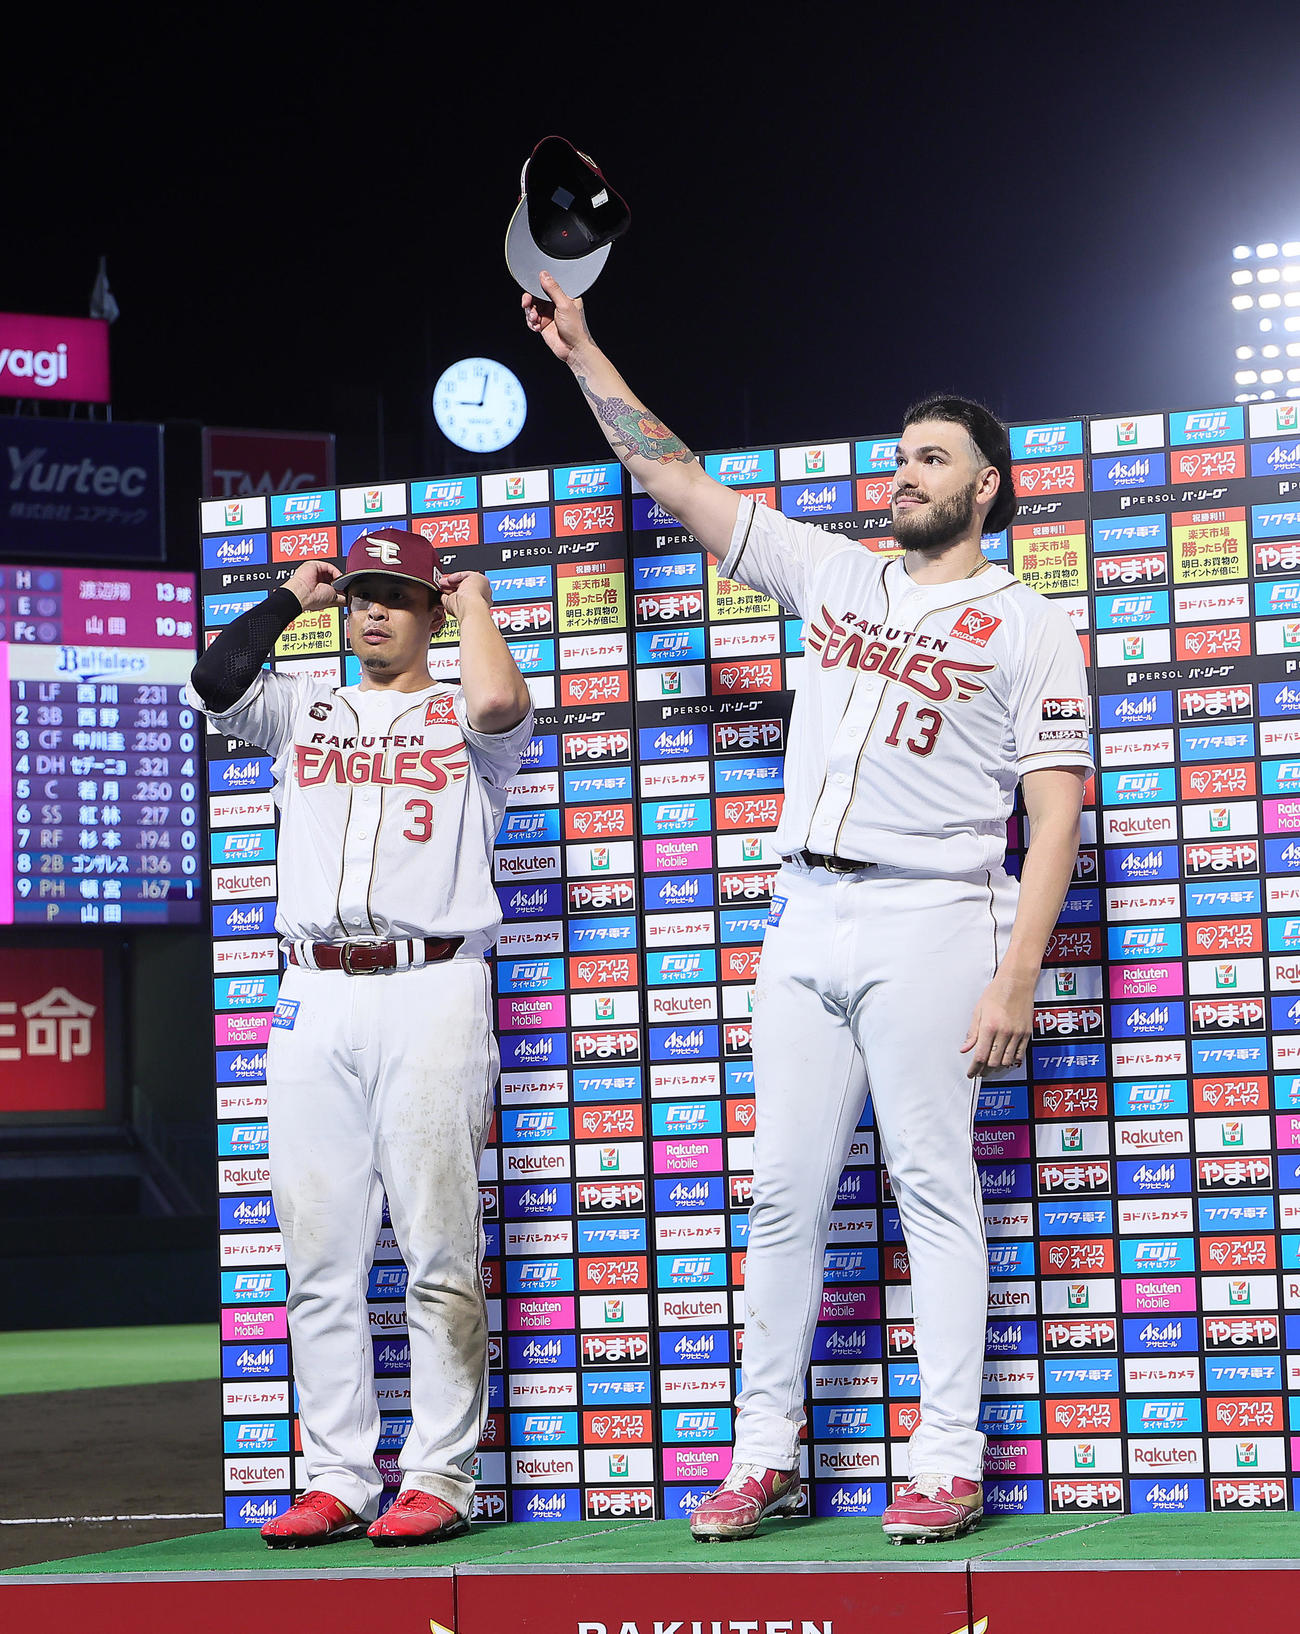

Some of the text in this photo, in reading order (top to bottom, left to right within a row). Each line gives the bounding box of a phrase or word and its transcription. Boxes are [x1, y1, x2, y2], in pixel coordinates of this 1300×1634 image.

[1186, 412, 1227, 430] Fuji
[1186, 429, 1226, 440] タイヤはフジ
[720, 455, 759, 472] Fuji
[1202, 452, 1236, 464] アイリス
[8, 446, 147, 498] Yurtec
[1108, 459, 1149, 479] Asahi
[1202, 462, 1235, 474] オーヤマ
[568, 468, 606, 485] Fuji
[721, 472, 757, 482] タイヤはフジ
[1114, 477, 1145, 486] アサヒビール
[569, 486, 604, 494] タイヤはフジ
[797, 486, 836, 506] Asahi
[1133, 494, 1176, 504] PERSOL
[584, 505, 614, 518] アイリス
[802, 504, 832, 512] アサヒビール
[584, 517, 614, 529] オーヤマ
[298, 532, 328, 544] アイリス
[1188, 527, 1229, 539] 楽天市場
[217, 538, 253, 557] Asahi
[300, 543, 328, 555] オーヤマ
[513, 547, 552, 557] PERSOL
[1099, 558, 1164, 584] やまや
[16, 570, 32, 589] H
[572, 578, 610, 590] 楽天市場
[18, 597, 31, 615] E
[639, 595, 700, 619] やまや
[1179, 596, 1244, 610] ヨドバシカメラ
[14, 622, 35, 640] Fc
[840, 611, 949, 651] RAKUTEN
[714, 634, 775, 646] ヨドバシカメラ
[564, 645, 623, 657] ヨドバシカメラ
[812, 611, 992, 702] EAGLES
[1139, 670, 1182, 680] PERSOL
[18, 681, 25, 699] 1
[39, 683, 61, 701] LF
[76, 684, 119, 704] 西川
[674, 705, 714, 714] PERSOL
[1184, 690, 1249, 716] やまや
[16, 705, 29, 725] 2
[38, 707, 62, 725] 3B
[77, 707, 119, 727] 西野
[179, 710, 194, 728] 0
[884, 701, 944, 758] 13
[16, 730, 29, 749] 3
[39, 730, 62, 749] CF
[72, 731, 125, 751] 中川圭
[179, 734, 194, 752] 0
[311, 733, 424, 749] RAKUTEN
[1105, 742, 1169, 754] ヨドバシカメラ
[16, 755, 30, 774] 4
[36, 756, 65, 774] DH
[181, 759, 194, 777] 4
[296, 742, 467, 793] EAGLES
[17, 780, 30, 799] 5
[45, 780, 58, 799] C
[180, 783, 194, 801] 0
[17, 804, 31, 823] 6
[41, 805, 62, 824] SS
[79, 805, 121, 825] 紅林
[180, 807, 195, 826] 0
[403, 799, 434, 844] 3
[1110, 818, 1170, 832] Rakuten
[17, 829, 30, 848] 7
[41, 829, 63, 848] RF
[78, 829, 121, 850] 杉本
[181, 831, 195, 850] 0
[656, 842, 698, 854] Rakuten
[18, 853, 31, 872] 8
[40, 855, 64, 873] 2B
[72, 854, 129, 873] ゴンザレス
[182, 856, 196, 874] 0
[656, 857, 688, 867] Mobile
[17, 878, 32, 897] 9
[40, 880, 65, 897] PH
[186, 880, 193, 899] 1
[217, 875, 271, 890] Rakuten
[47, 903, 121, 923] P 山田
[1124, 968, 1168, 980] Rakuten
[1124, 983, 1157, 994] Mobile
[274, 1000, 297, 1018] Fuji
[653, 997, 711, 1010] Rakuten
[1136, 1243, 1177, 1258] Fuji
[1137, 1259, 1176, 1269] タイヤはフジ
[235, 1274, 272, 1289] Fuji
[235, 1290, 270, 1298] タイヤはフジ
[520, 1301, 561, 1313] Rakuten
[234, 1312, 274, 1322] Rakuten
[520, 1316, 550, 1326] Mobile
[235, 1326, 264, 1336] Mobile
[237, 1349, 274, 1368] Asahi
[820, 1453, 879, 1468] Rakuten
[1134, 1447, 1197, 1463] Rakuten
[230, 1466, 284, 1480] Rakuten
[517, 1460, 573, 1473] Rakuten
[590, 1491, 651, 1515] やまや
